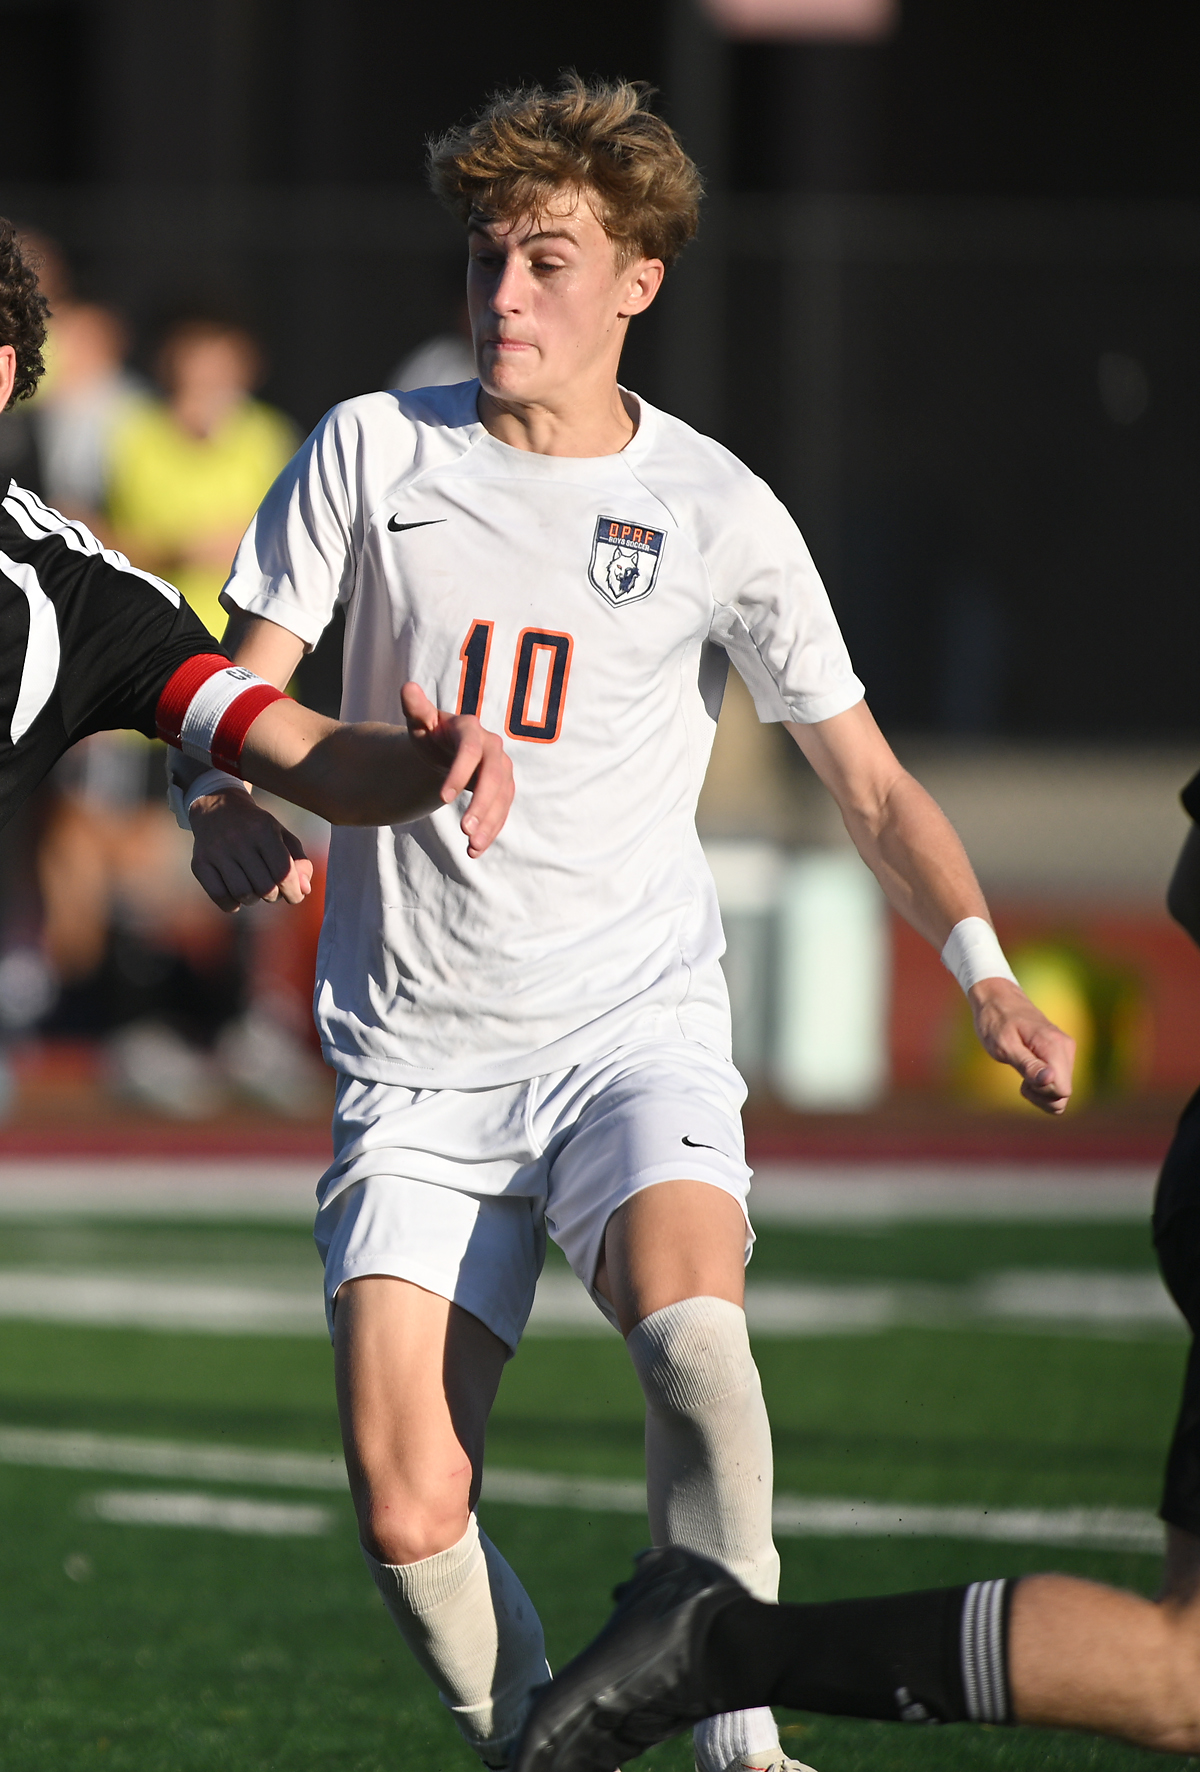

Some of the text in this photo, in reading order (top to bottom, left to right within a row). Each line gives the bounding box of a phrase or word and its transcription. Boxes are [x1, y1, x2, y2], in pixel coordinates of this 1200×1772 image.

[608, 535, 651, 552] BOYS SOCCER
[609, 522, 655, 545] OPRF
[455, 618, 574, 744] 10
